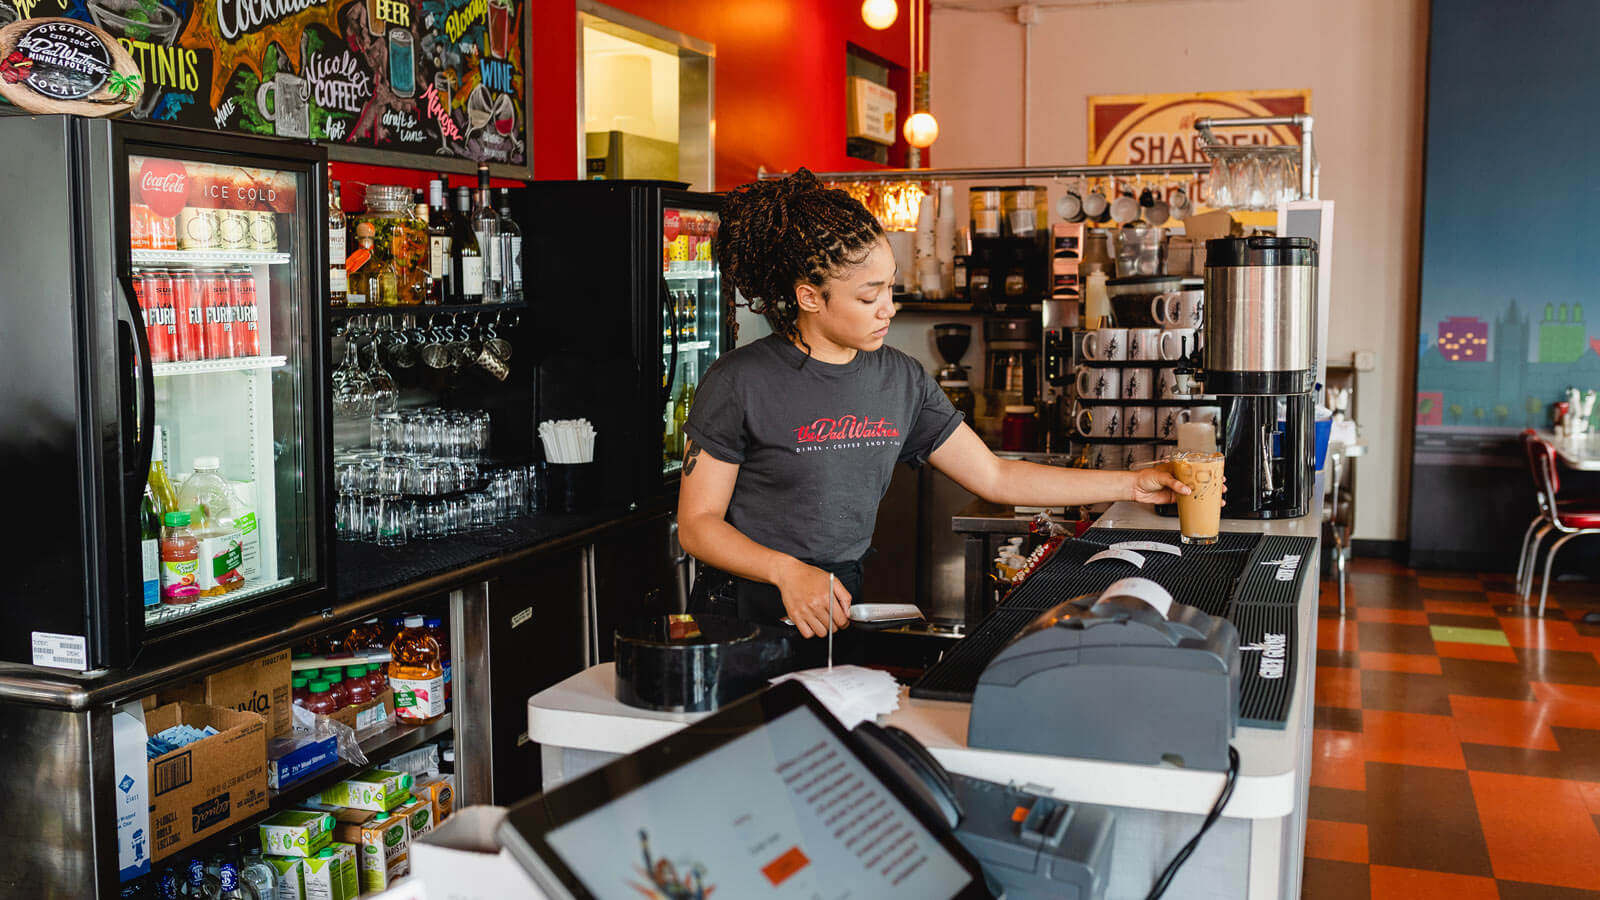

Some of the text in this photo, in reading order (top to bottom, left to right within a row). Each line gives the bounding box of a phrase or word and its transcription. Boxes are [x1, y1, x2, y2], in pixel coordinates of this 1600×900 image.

[375, 0, 411, 27] BEER
[39, 25, 100, 48] ORGANIC
[28, 52, 94, 75] MINNEAPOLIS
[30, 72, 81, 95] LOCAL
[480, 58, 514, 94] WINE
[315, 79, 361, 113] COFFEE
[213, 97, 236, 130] MULE
[142, 170, 186, 194] Coca-Cola
[203, 184, 277, 202] ICE COLD
[833, 442, 860, 450] COFFEE
